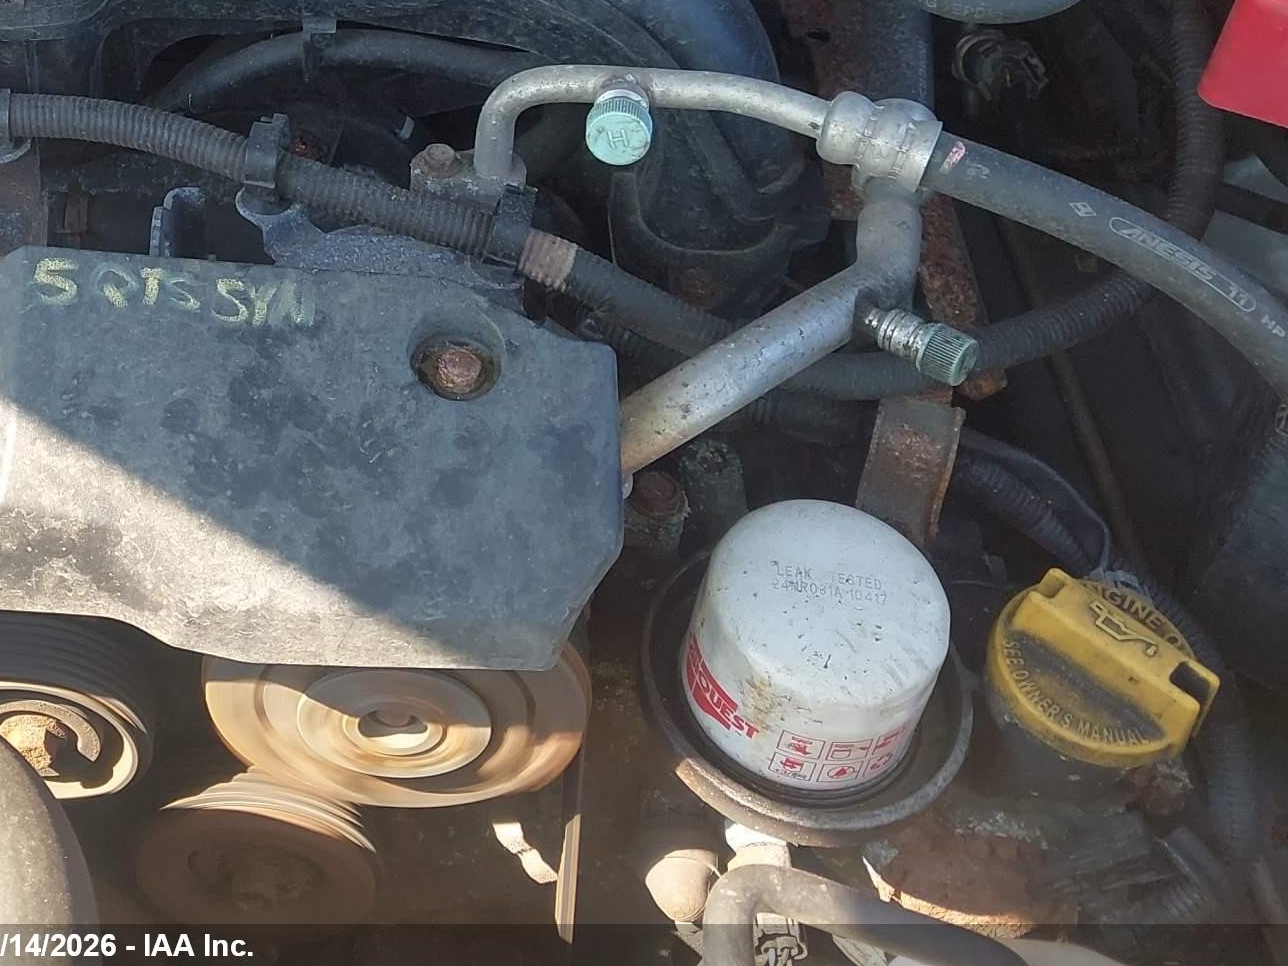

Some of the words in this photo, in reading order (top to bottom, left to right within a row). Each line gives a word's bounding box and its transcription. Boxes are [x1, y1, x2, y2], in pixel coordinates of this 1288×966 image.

[606, 128, 630, 149] H
[33, 257, 78, 306] 5
[96, 265, 201, 315] QTS
[773, 563, 813, 580] LEAK
[1002, 640, 1025, 666] SEE
[1077, 719, 1149, 747] MANUAL
